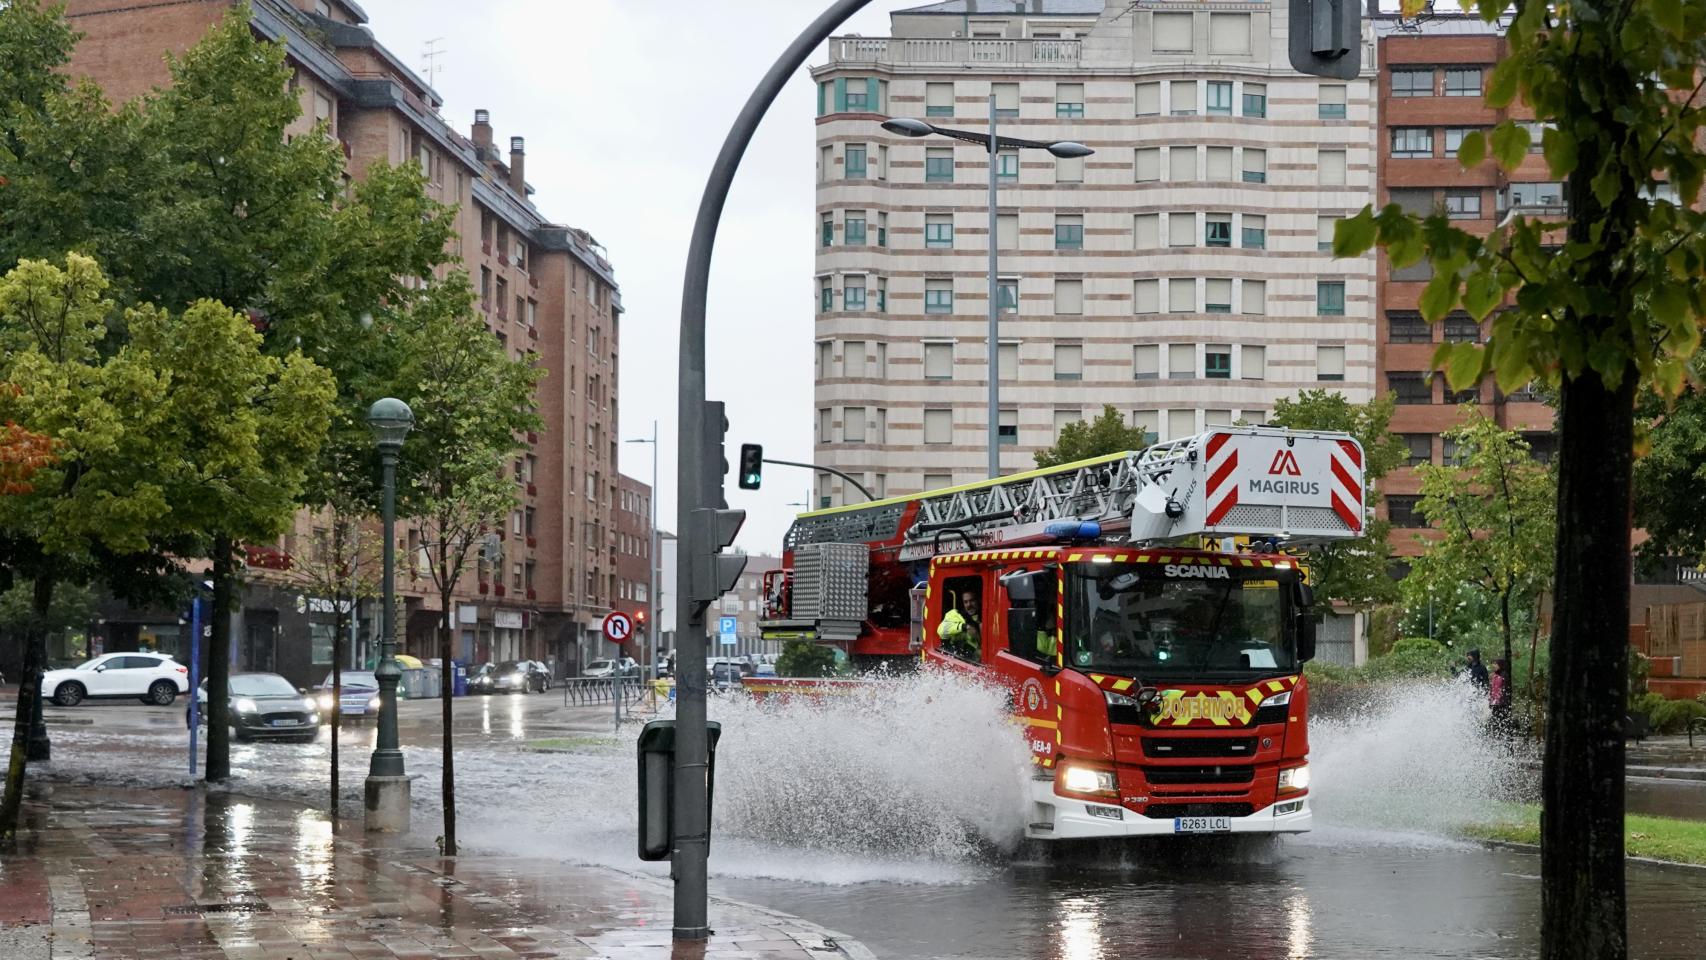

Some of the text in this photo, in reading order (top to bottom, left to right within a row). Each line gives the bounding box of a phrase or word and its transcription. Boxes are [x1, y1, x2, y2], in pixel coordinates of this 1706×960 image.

[1250, 479, 1319, 495] MAGIRUS
[1164, 564, 1230, 579] SCANIA
[723, 619, 733, 631] P
[1182, 818, 1228, 830] 6263 LCL
